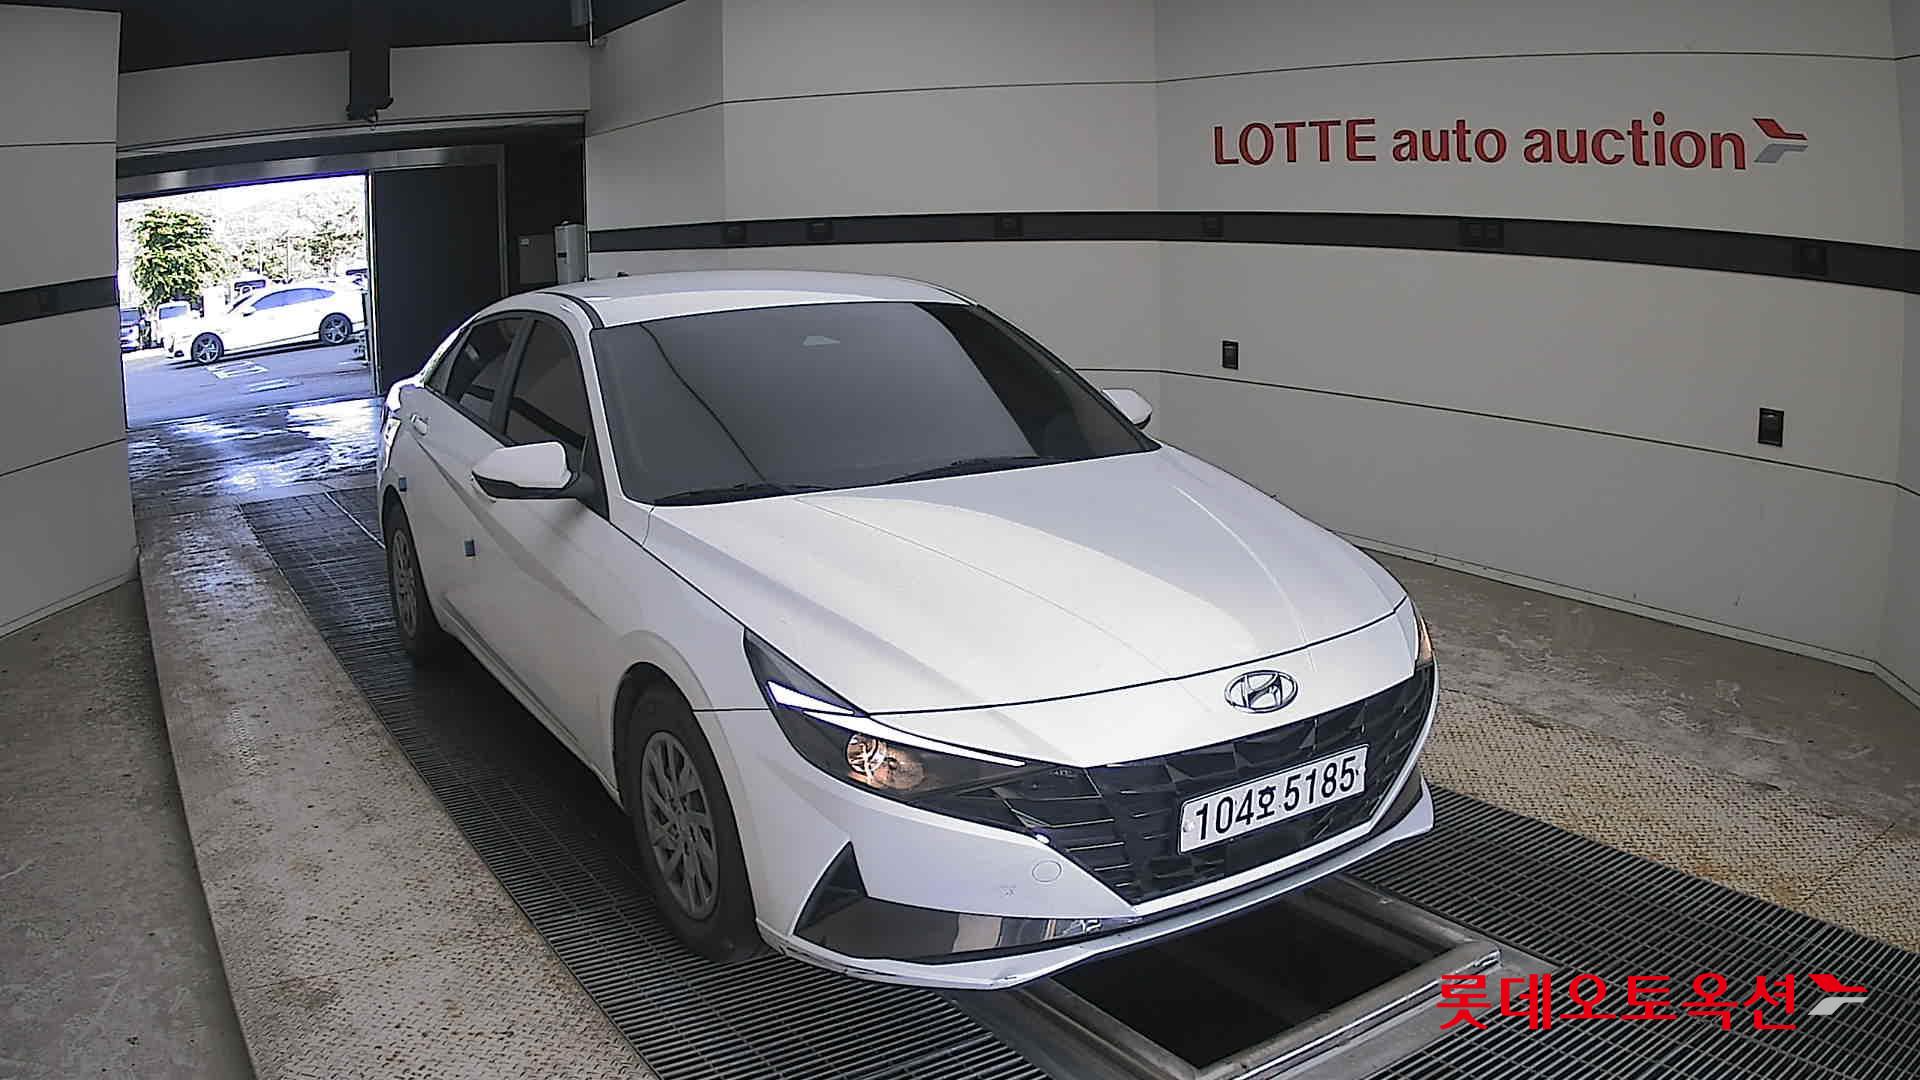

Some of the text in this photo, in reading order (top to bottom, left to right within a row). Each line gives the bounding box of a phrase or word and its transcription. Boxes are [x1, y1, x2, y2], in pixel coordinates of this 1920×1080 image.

[1213, 111, 1746, 170] LOTTE auto auction
[1284, 756, 1356, 811] 5185
